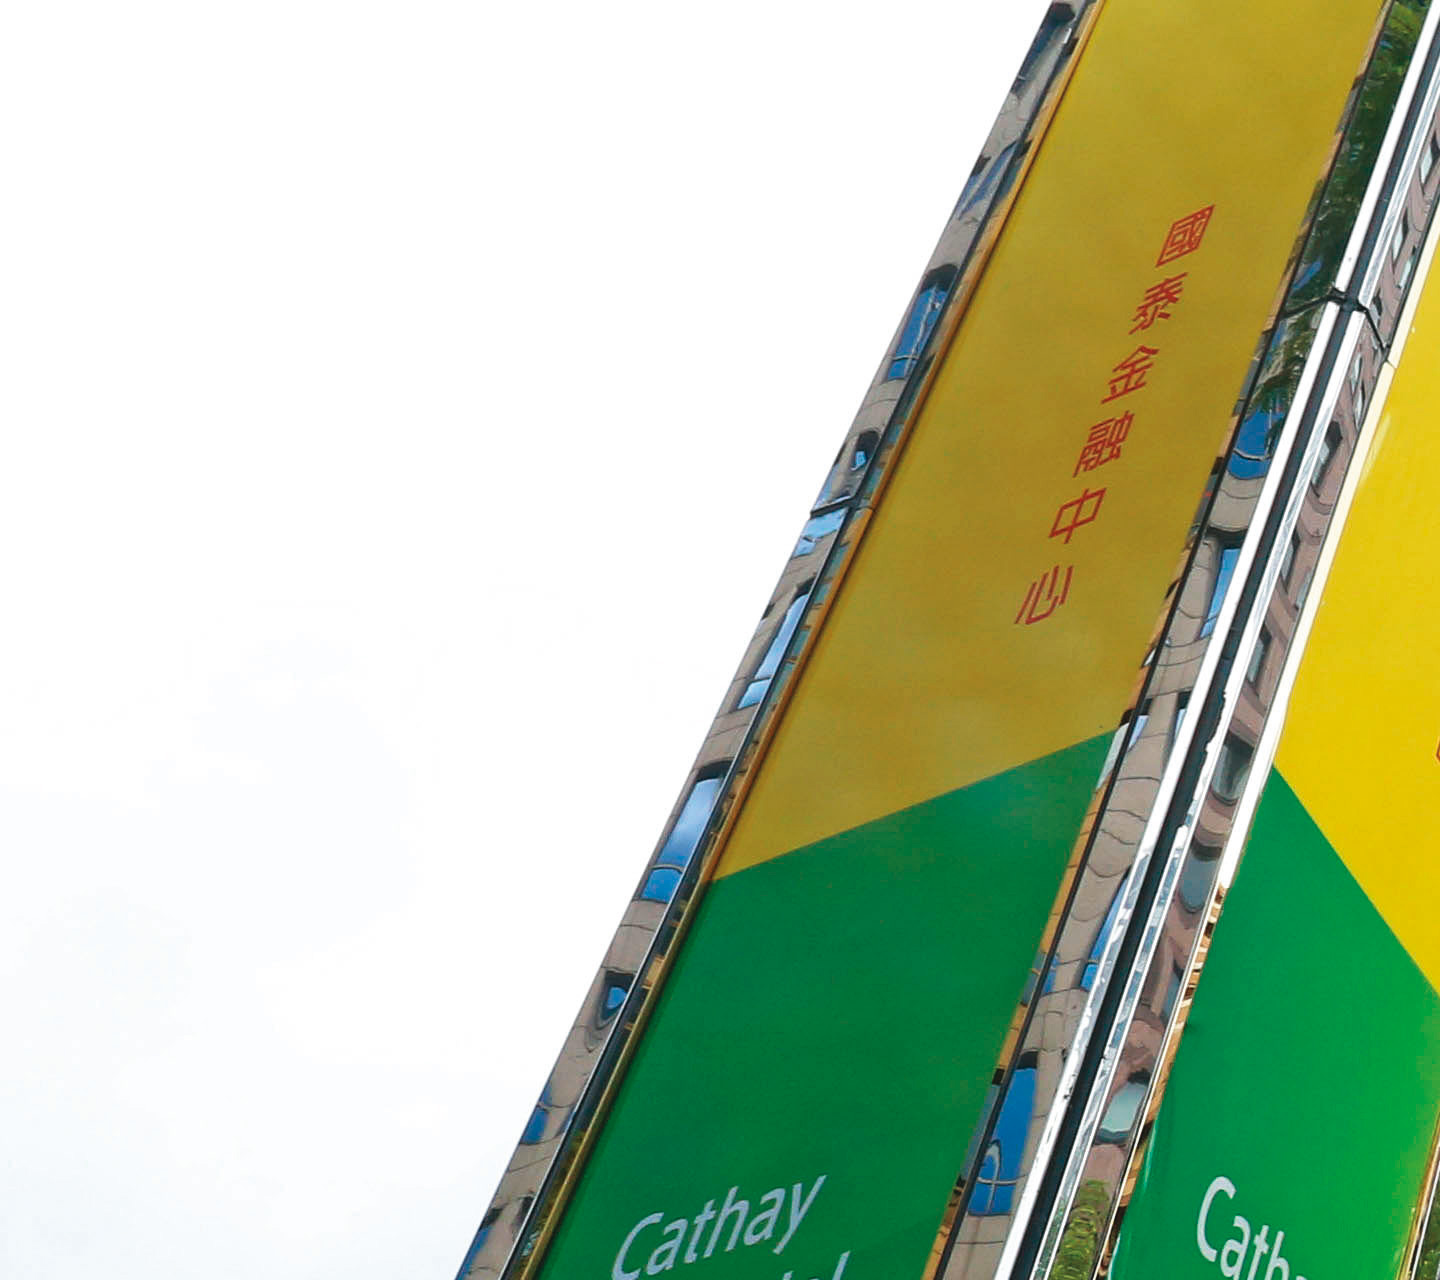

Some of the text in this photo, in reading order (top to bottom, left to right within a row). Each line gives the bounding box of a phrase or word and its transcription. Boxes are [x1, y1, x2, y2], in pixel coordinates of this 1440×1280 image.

[1013, 203, 1216, 626] 國泰金融中心
